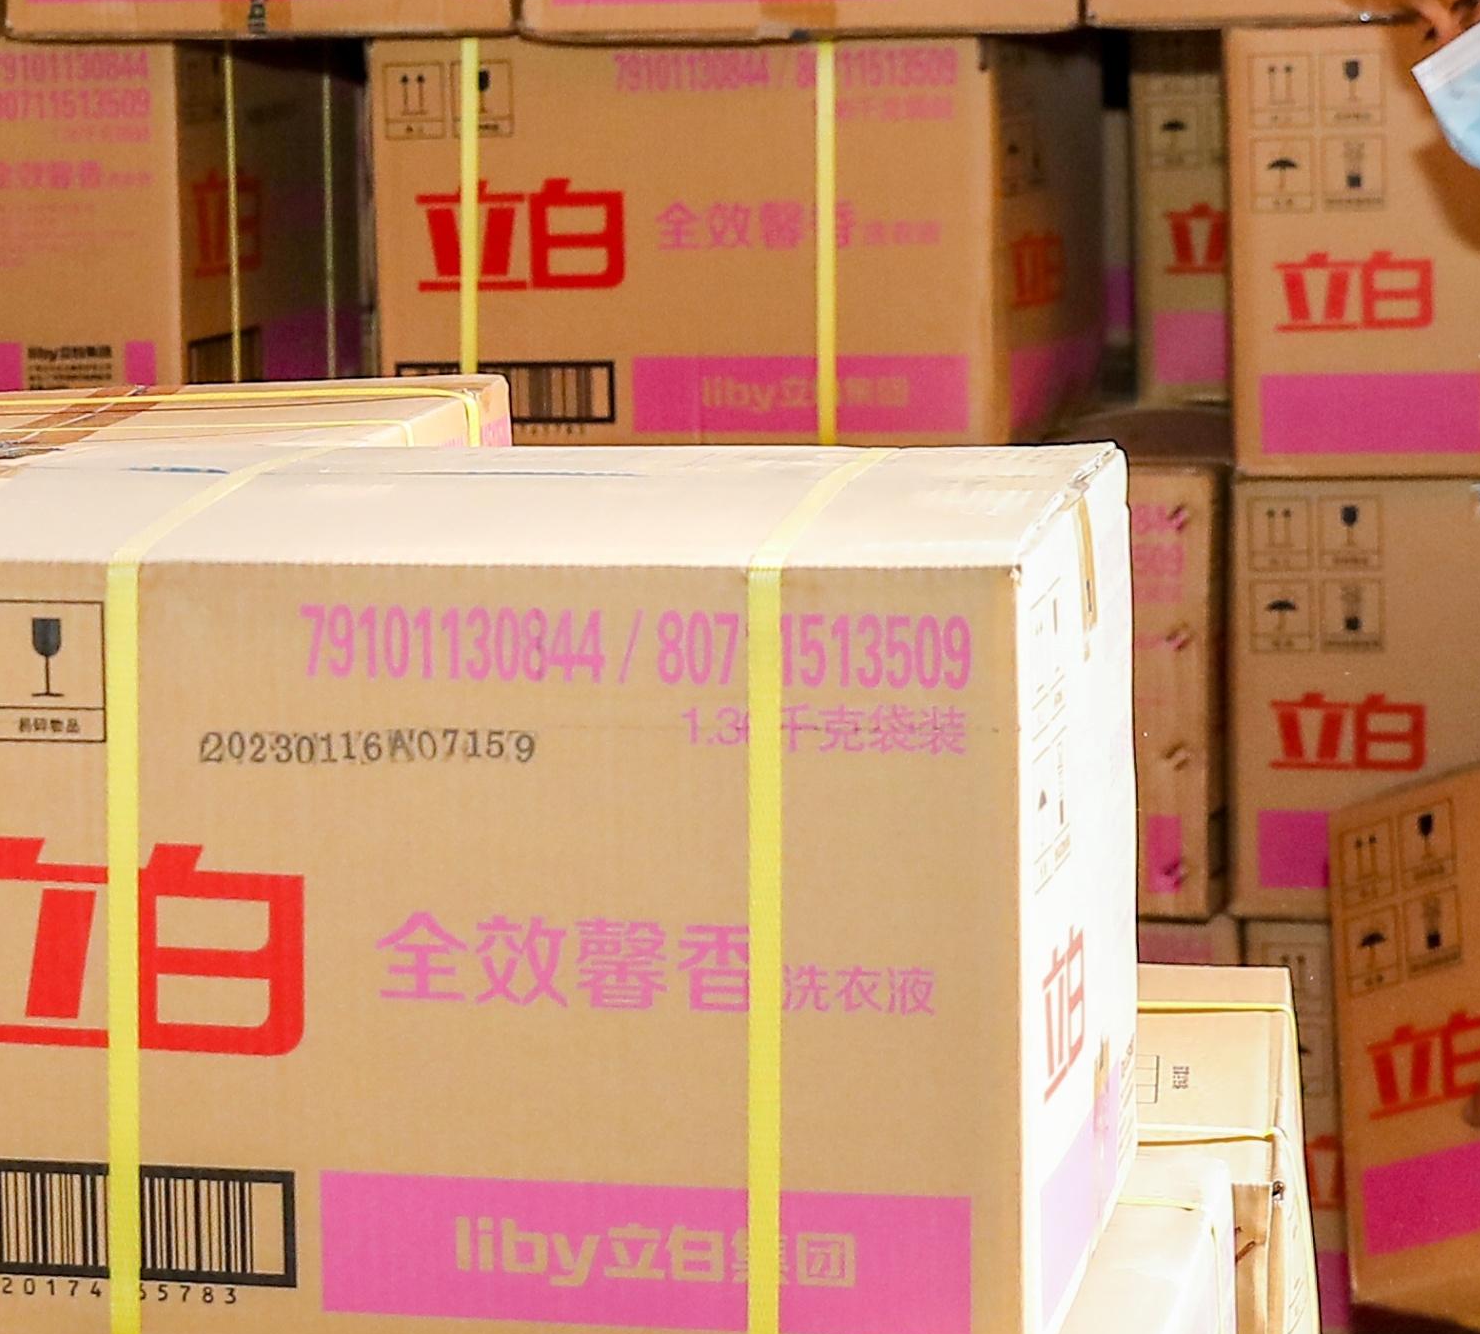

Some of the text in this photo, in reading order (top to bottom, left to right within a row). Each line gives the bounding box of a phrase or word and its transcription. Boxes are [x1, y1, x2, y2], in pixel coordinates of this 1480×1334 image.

[418, 178, 625, 292] 立白
[1169, 204, 1226, 273] 立
[1277, 251, 1433, 332] 立白
[302, 604, 972, 690] 79101130844 / 8071513509
[682, 703, 966, 755] 1.3千克袋装
[1272, 693, 1426, 771] 立白
[377, 912, 934, 1015] 全效馨香 洗衣液
[1042, 923, 1085, 1104] 立白
